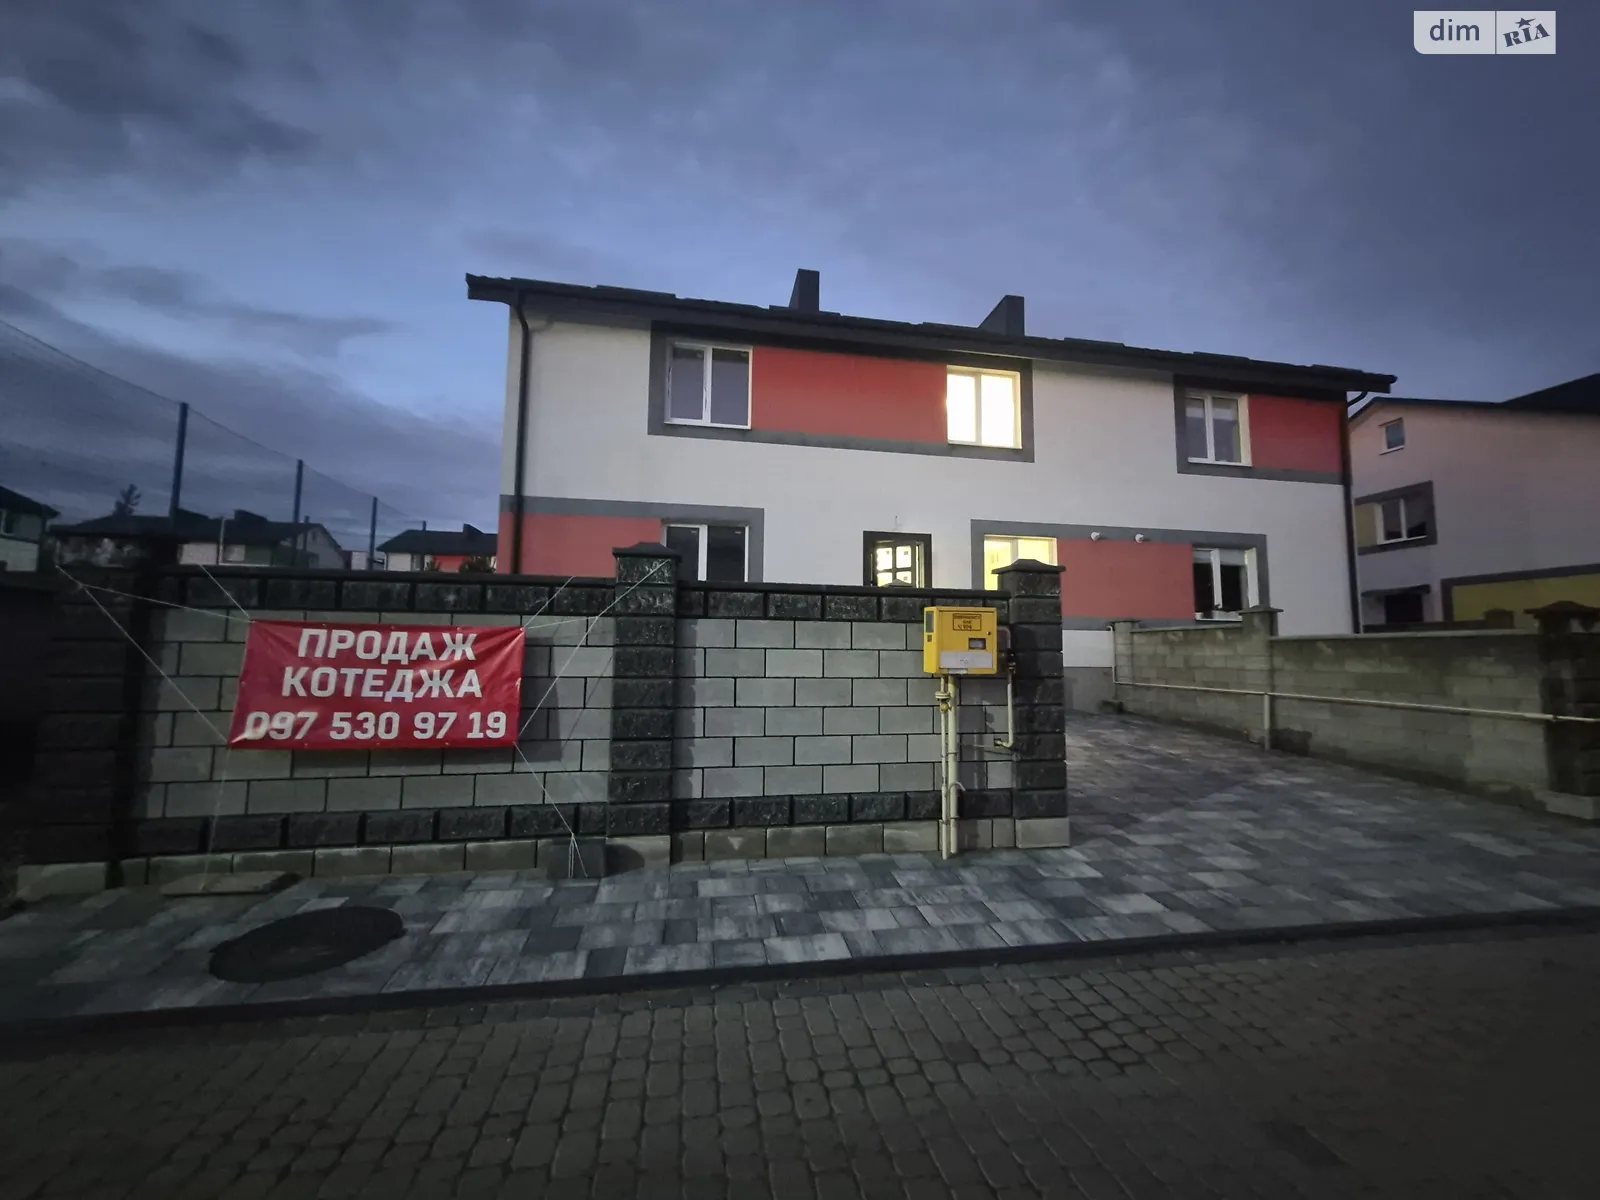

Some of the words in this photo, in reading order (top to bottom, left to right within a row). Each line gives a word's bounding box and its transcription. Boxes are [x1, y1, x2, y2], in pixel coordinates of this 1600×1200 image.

[297, 628, 478, 665] ПРОДАЖ
[281, 666, 483, 703] КОТЕДЖА
[245, 711, 318, 740] 097
[329, 711, 400, 740] 530
[413, 711, 457, 740] 97
[466, 711, 507, 739] 19
